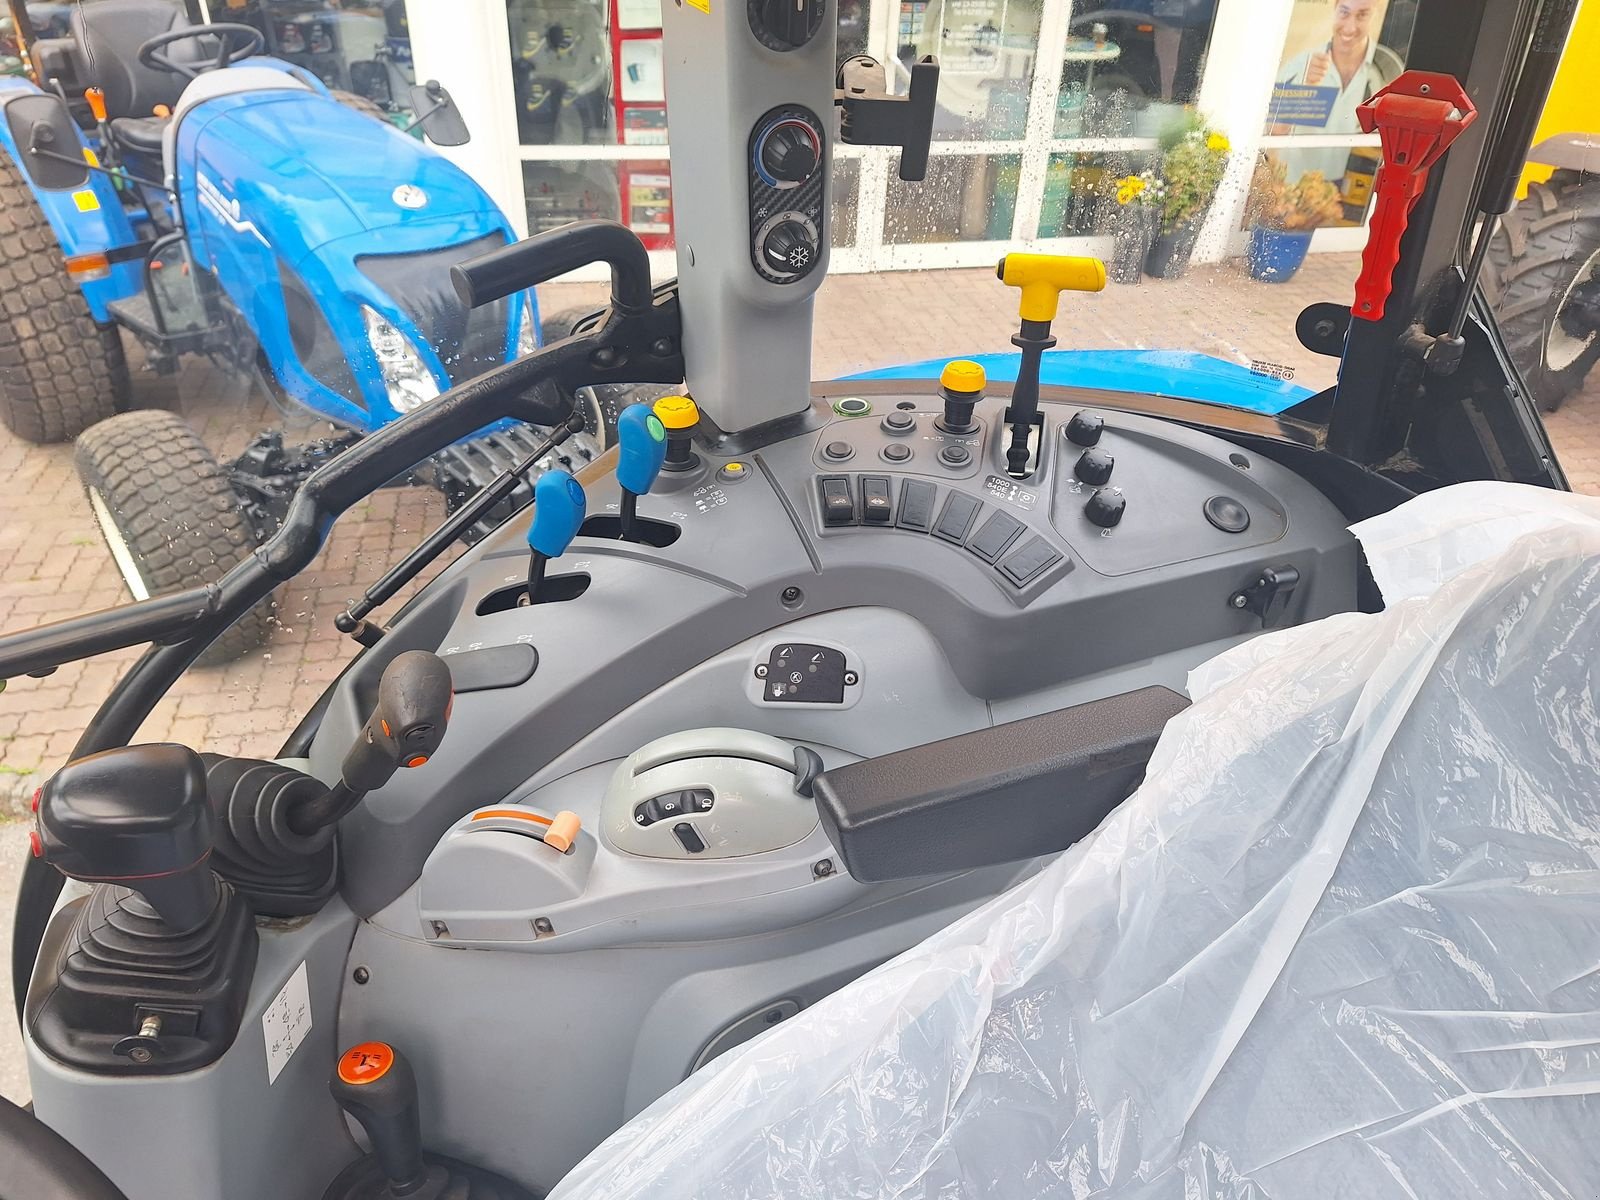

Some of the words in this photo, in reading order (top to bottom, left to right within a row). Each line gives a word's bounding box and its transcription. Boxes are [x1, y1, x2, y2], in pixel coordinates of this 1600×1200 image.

[987, 482, 1008, 494] 540E
[991, 477, 1010, 488] 1000
[990, 489, 1005, 499] 540
[701, 798, 712, 809] 10
[636, 814, 645, 823] 8
